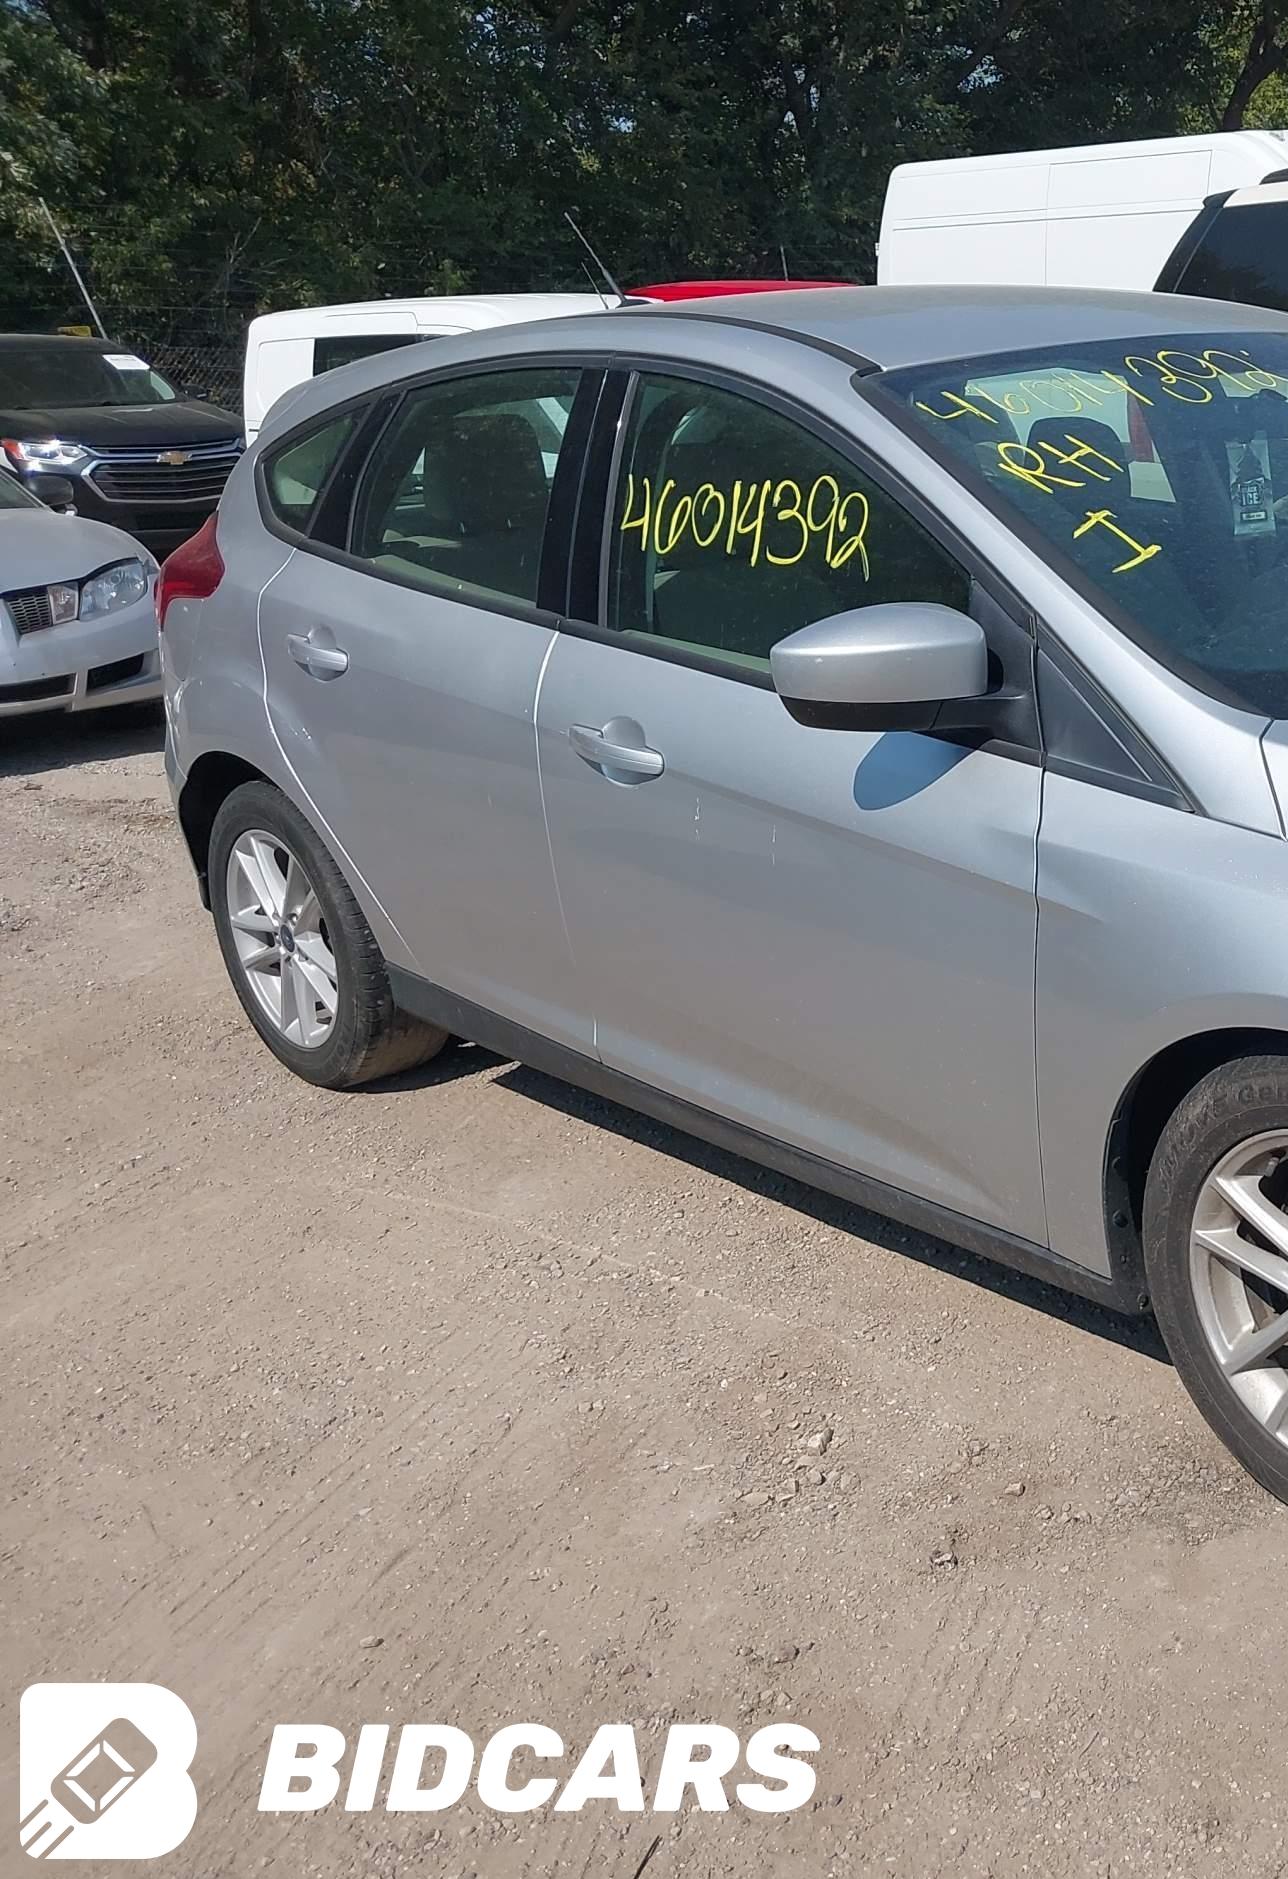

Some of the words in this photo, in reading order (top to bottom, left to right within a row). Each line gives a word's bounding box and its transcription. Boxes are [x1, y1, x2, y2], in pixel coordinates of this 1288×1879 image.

[997, 433, 1125, 495] RH
[620, 473, 871, 583] 46014392
[1242, 492, 1259, 506] ICE
